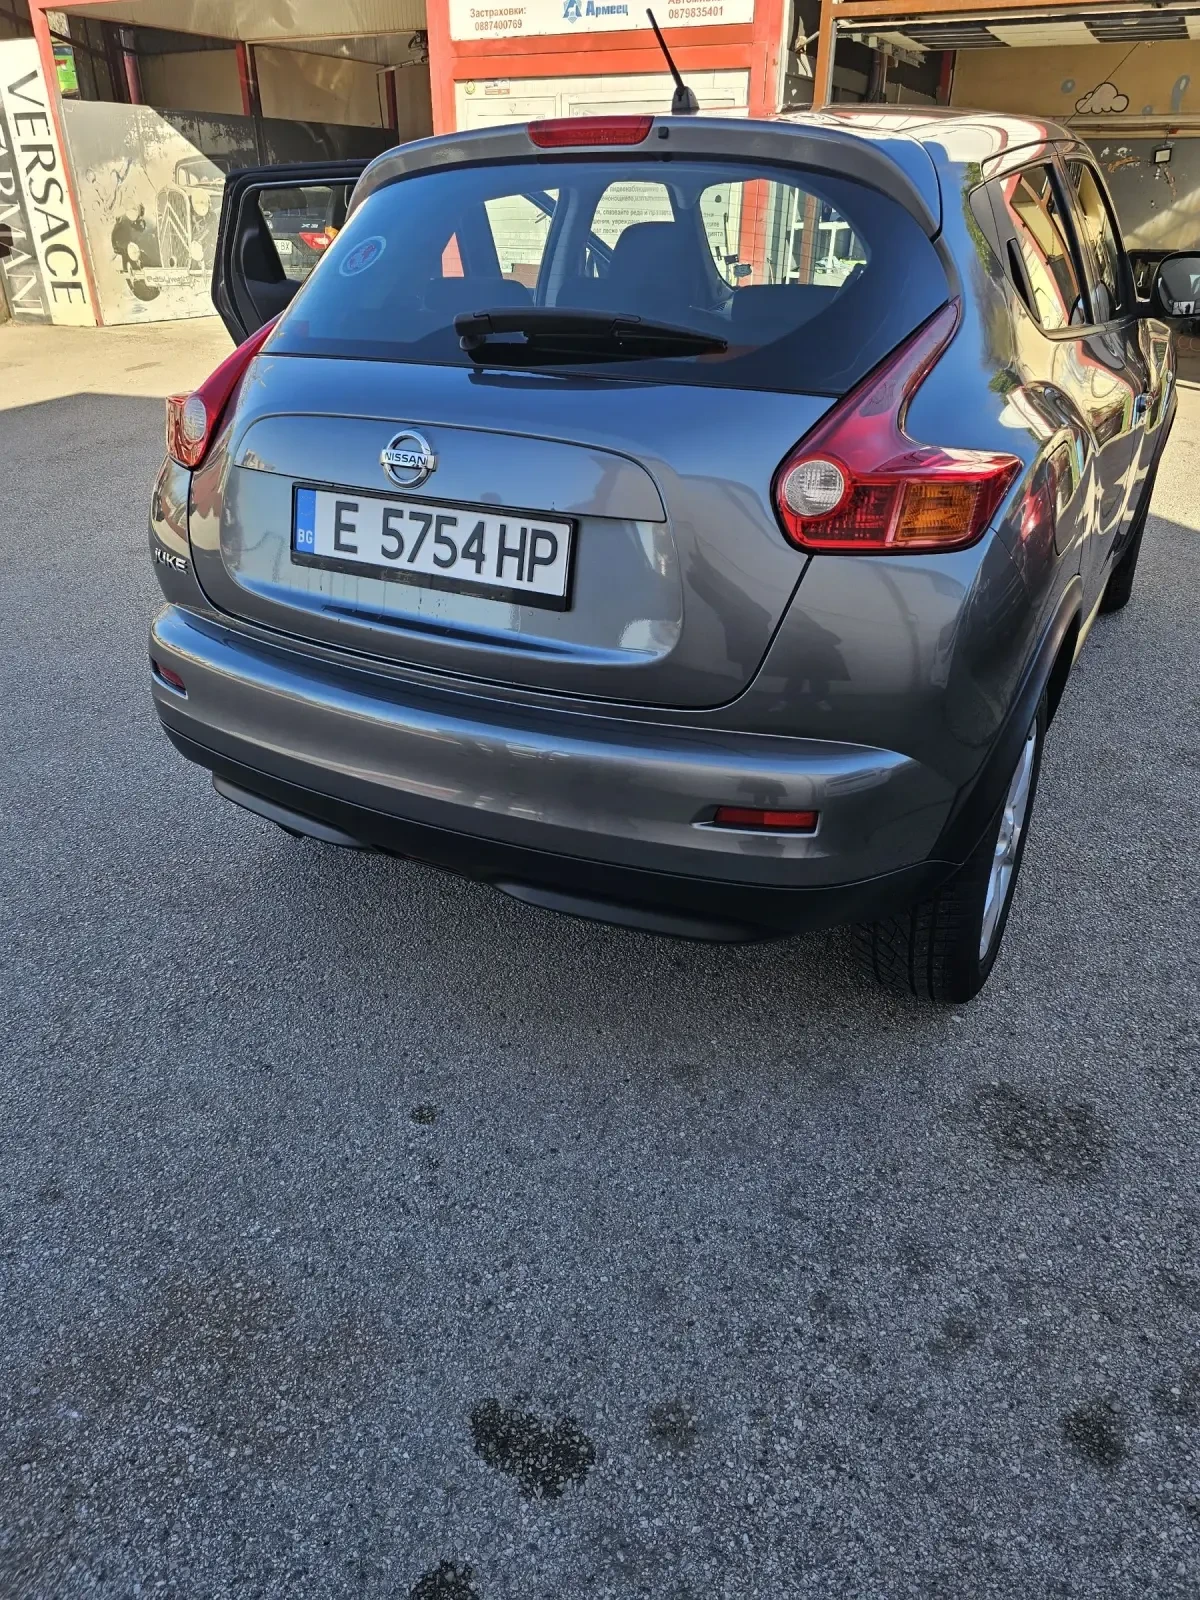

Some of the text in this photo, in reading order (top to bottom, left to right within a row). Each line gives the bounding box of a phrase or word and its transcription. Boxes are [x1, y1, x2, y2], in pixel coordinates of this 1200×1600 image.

[470, 7, 527, 19] Застраховки:
[586, 0, 629, 18] Армеец
[668, 6, 723, 19] 0879835401
[474, 19, 523, 31] 0887400769
[7, 70, 87, 305] VERSACE
[385, 452, 427, 466] NISSAN
[297, 527, 314, 545] BG
[334, 500, 559, 582] E 5754 HP
[154, 547, 187, 574] JUKE
